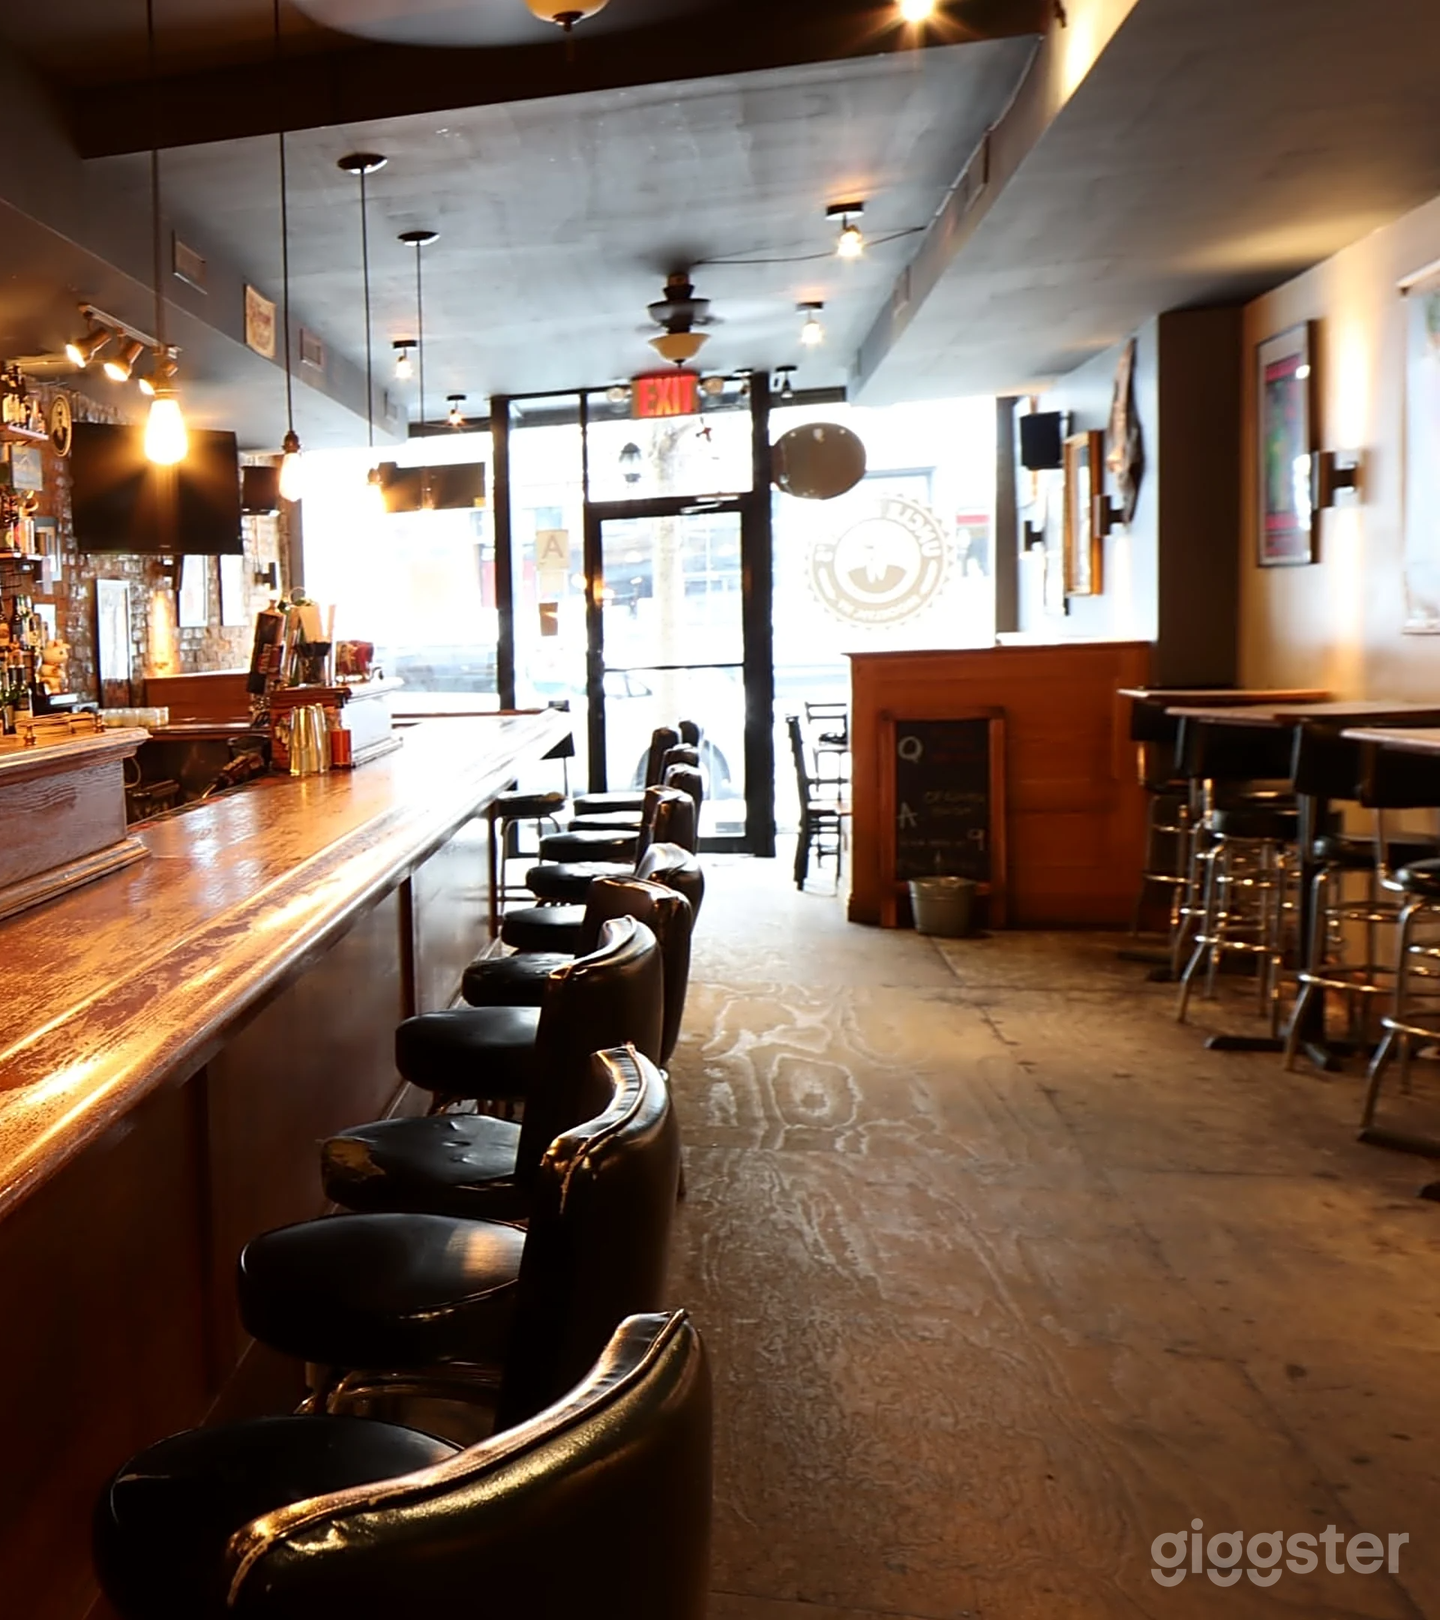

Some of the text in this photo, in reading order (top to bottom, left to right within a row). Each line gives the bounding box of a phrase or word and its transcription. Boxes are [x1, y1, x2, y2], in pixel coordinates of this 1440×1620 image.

[639, 376, 696, 416] EXIT
[541, 534, 564, 559] A
[897, 735, 923, 763] Q
[897, 802, 918, 829] A
